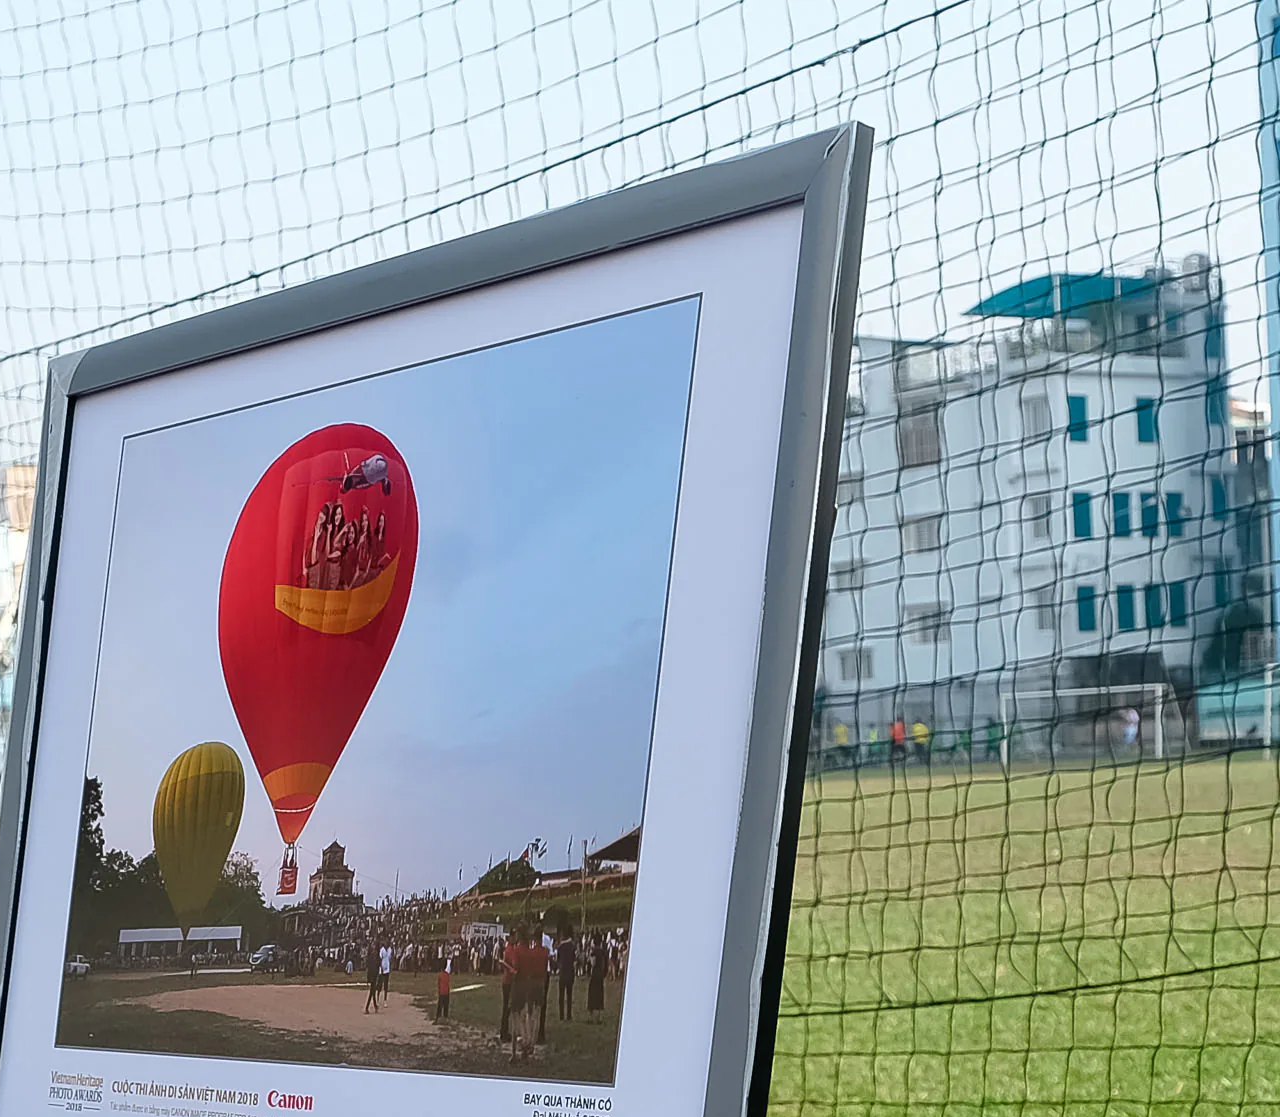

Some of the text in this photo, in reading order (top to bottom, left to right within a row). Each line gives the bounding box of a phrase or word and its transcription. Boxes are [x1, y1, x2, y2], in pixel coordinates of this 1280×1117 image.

[49, 1086, 103, 1103] PHOTO AWARDS
[134, 1082, 148, 1096] THI
[148, 1080, 167, 1098] ẢNH
[168, 1085, 177, 1099] DI
[177, 1083, 196, 1100] SẢN
[195, 1086, 215, 1105] VIỆT
[215, 1089, 236, 1104] NAM
[237, 1091, 259, 1106] 2018
[267, 1089, 313, 1111] Canon
[524, 1093, 542, 1106] BAY
[543, 1095, 563, 1107] QUA
